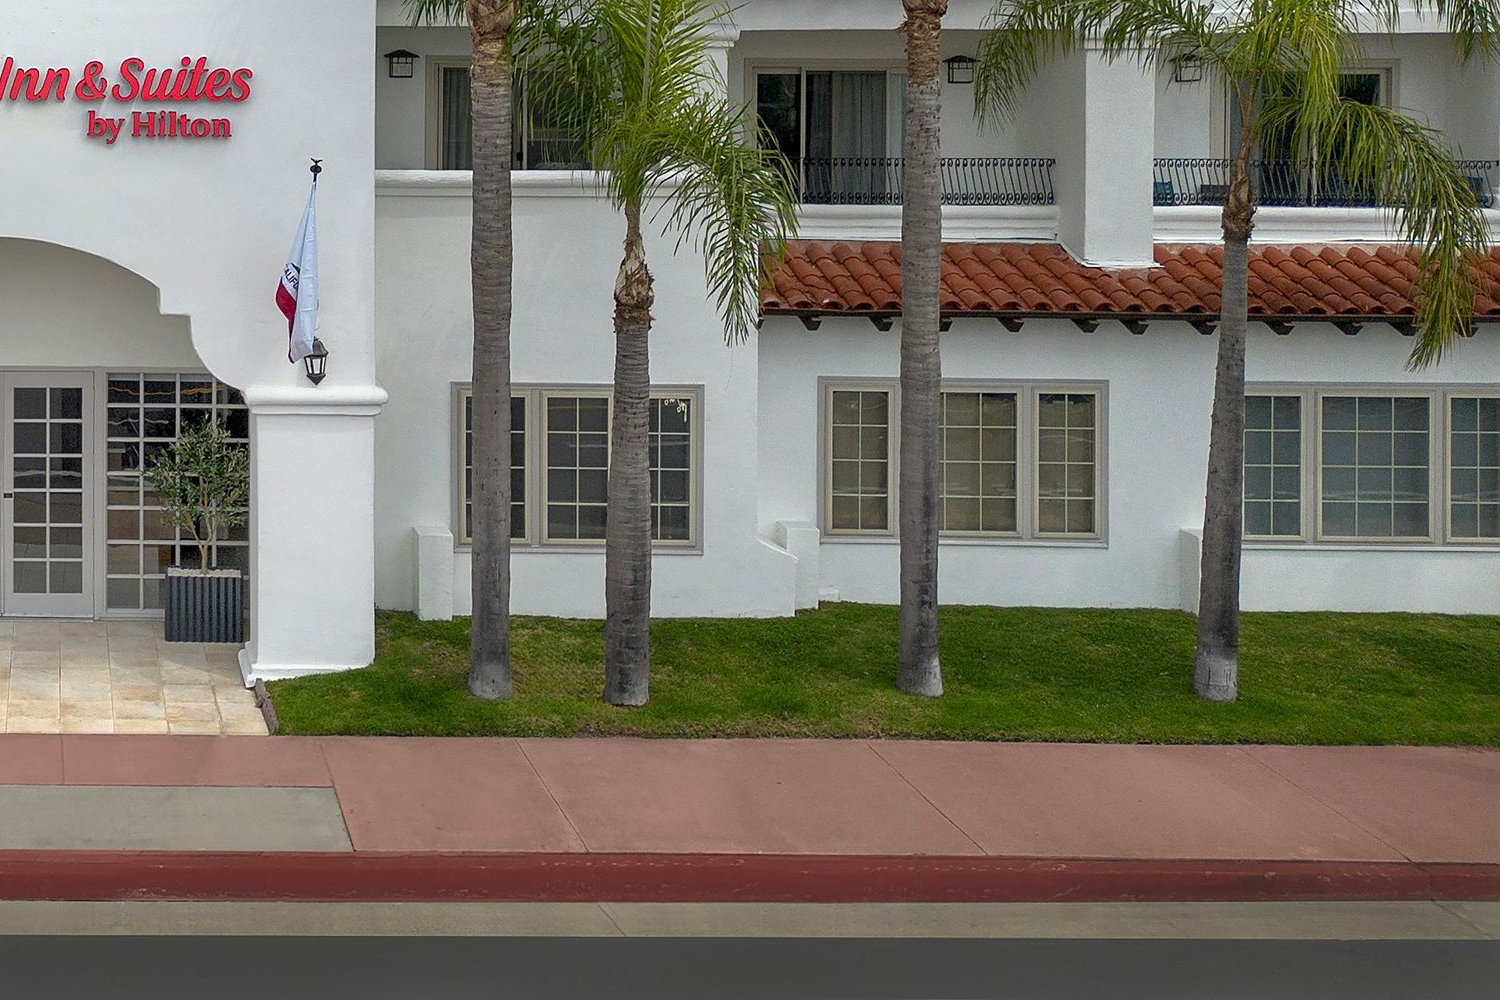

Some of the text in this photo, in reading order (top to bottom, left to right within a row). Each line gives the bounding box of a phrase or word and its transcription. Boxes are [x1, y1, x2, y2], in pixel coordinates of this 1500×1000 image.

[74, 60, 109, 102] &
[111, 55, 254, 103] Suites
[86, 110, 232, 145] by Hilton
